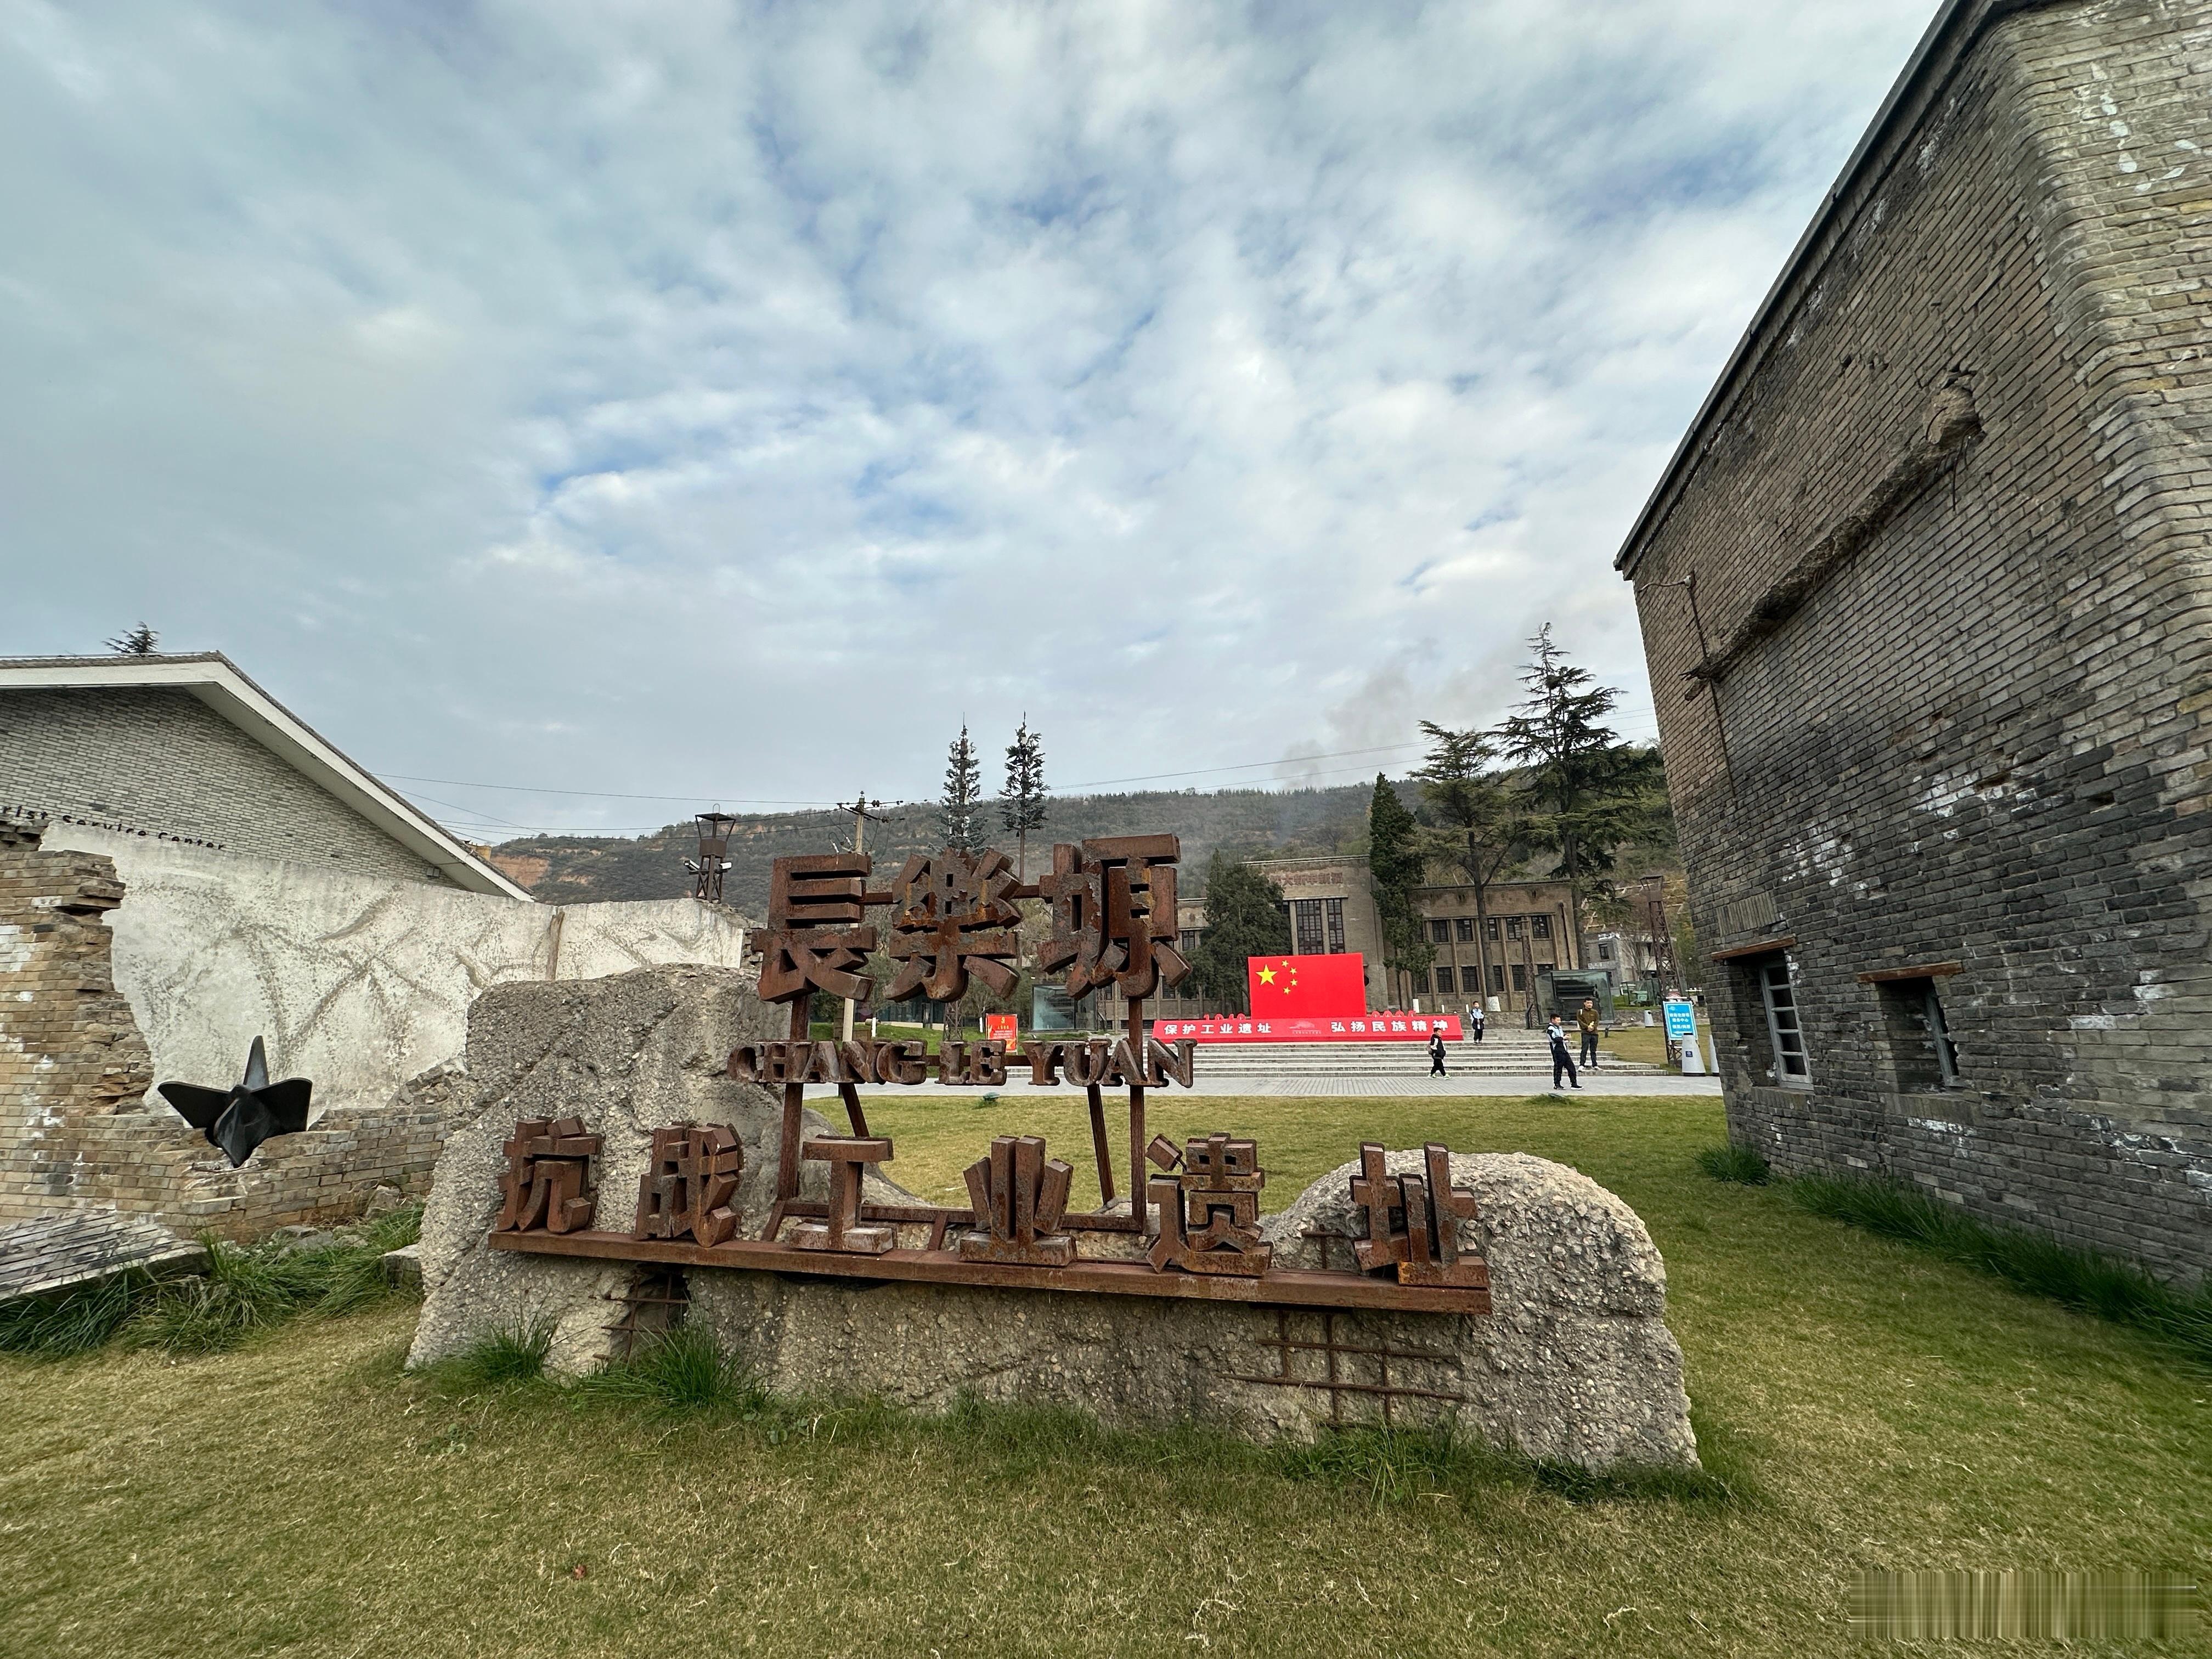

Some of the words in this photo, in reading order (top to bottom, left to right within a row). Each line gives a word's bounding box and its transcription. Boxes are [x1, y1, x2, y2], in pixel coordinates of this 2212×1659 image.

[1164, 1022, 1272, 1035] 保护工业遗址
[1330, 1019, 1449, 1033] 弘扬民族精神
[726, 1039, 928, 1086] CHANG
[934, 1039, 1007, 1086] LE
[1022, 1037, 1198, 1088] YUAN
[496, 1115, 1490, 1288] 抗战工业遗址
